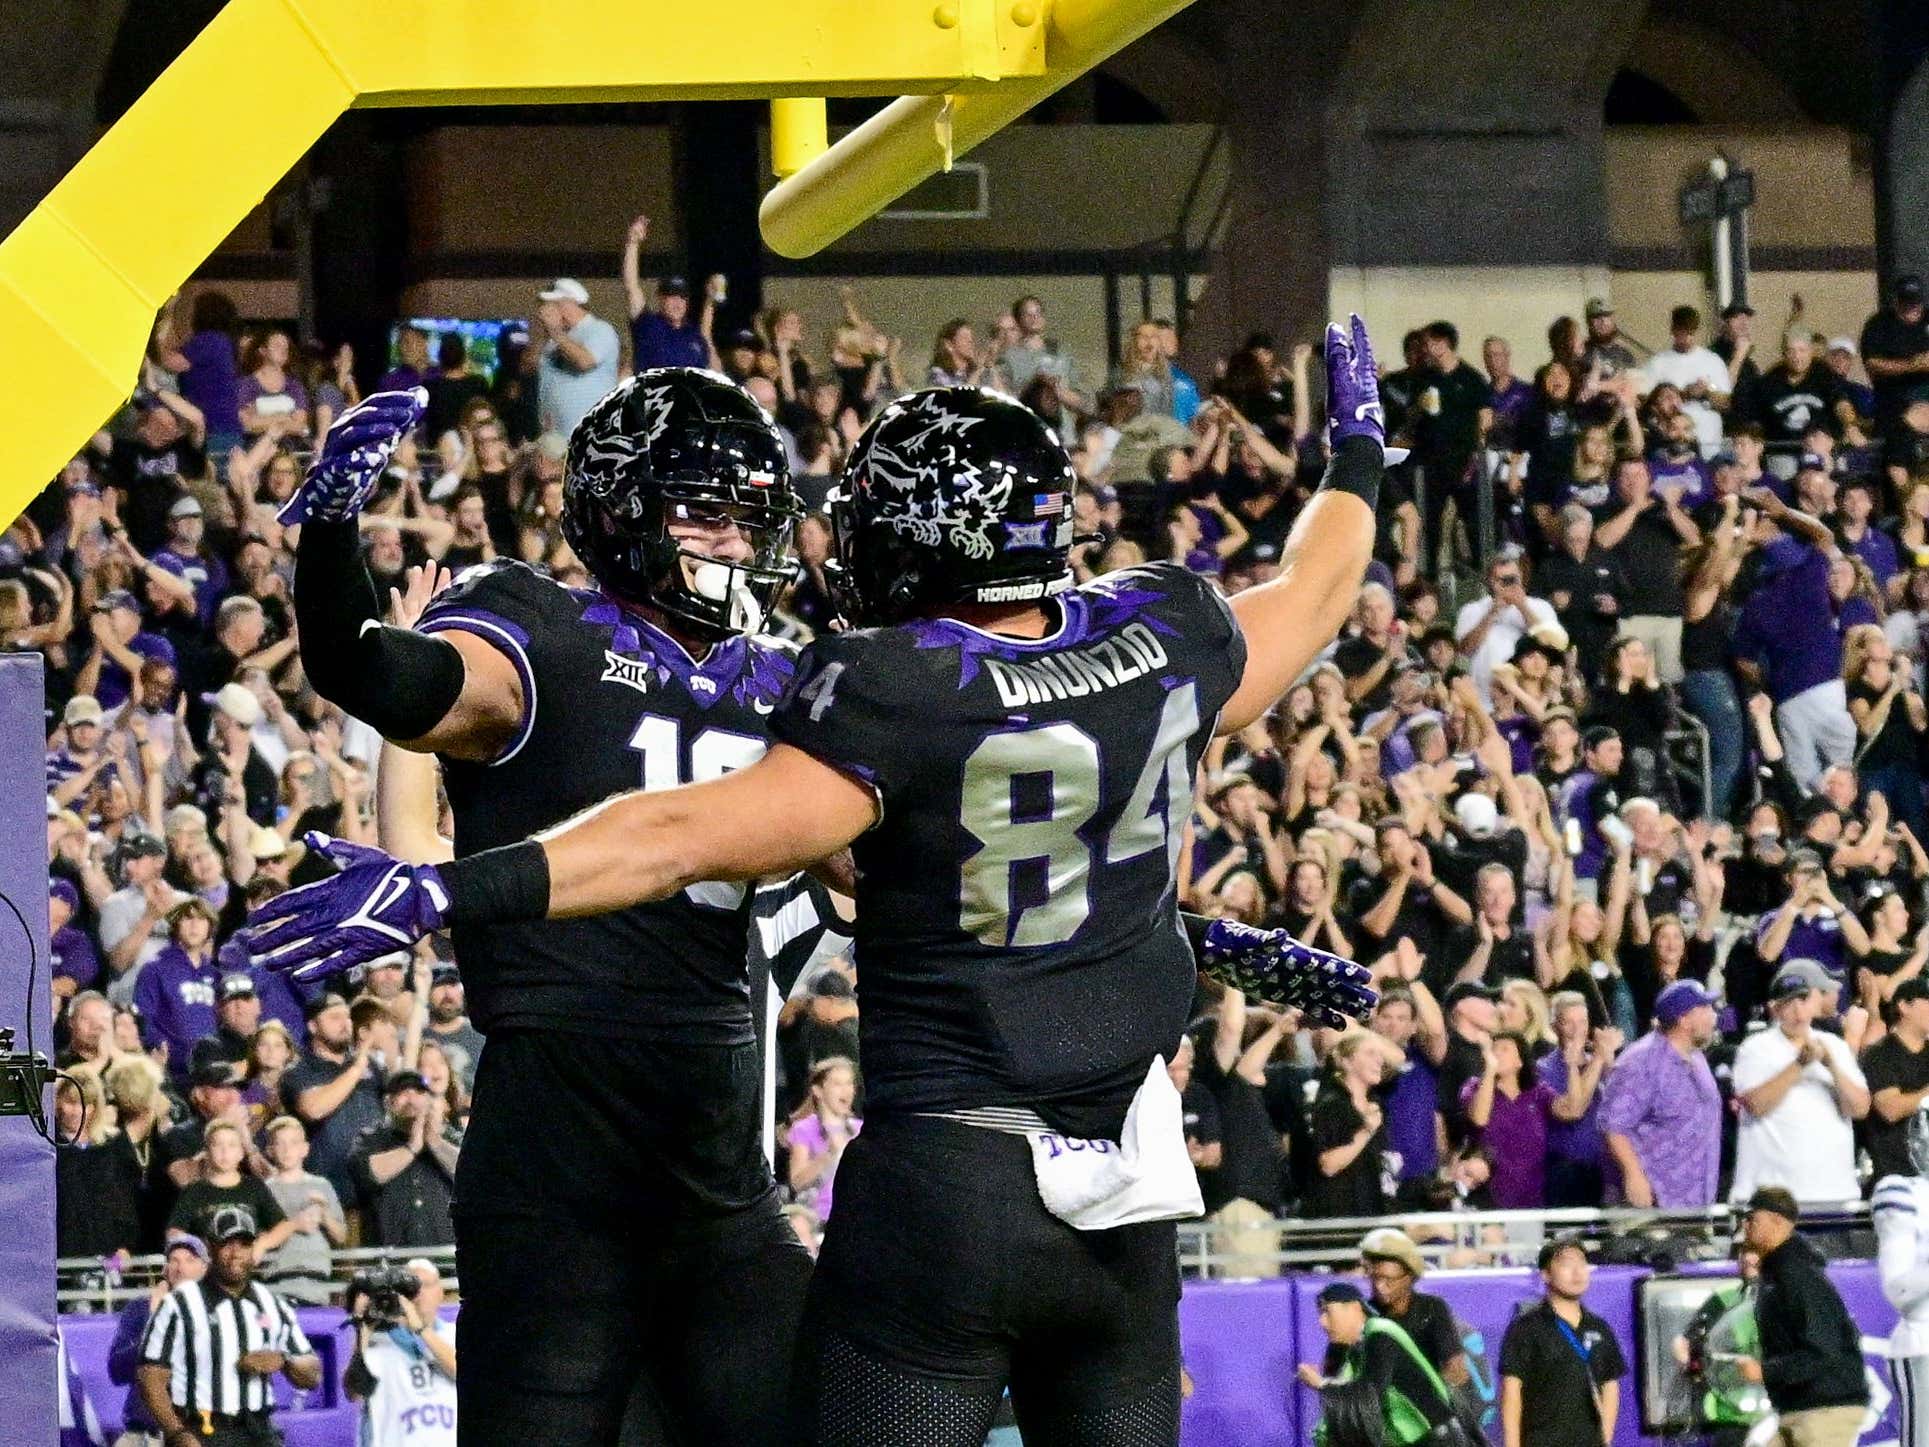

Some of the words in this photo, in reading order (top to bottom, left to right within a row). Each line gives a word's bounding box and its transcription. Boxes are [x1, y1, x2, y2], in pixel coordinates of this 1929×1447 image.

[977, 582, 1045, 603] HORNED
[689, 675, 717, 695] TCU
[984, 622, 1168, 708] DINUNZIO
[799, 662, 845, 722] 4
[959, 682, 1199, 947] 84
[400, 1404, 455, 1435] TCU
